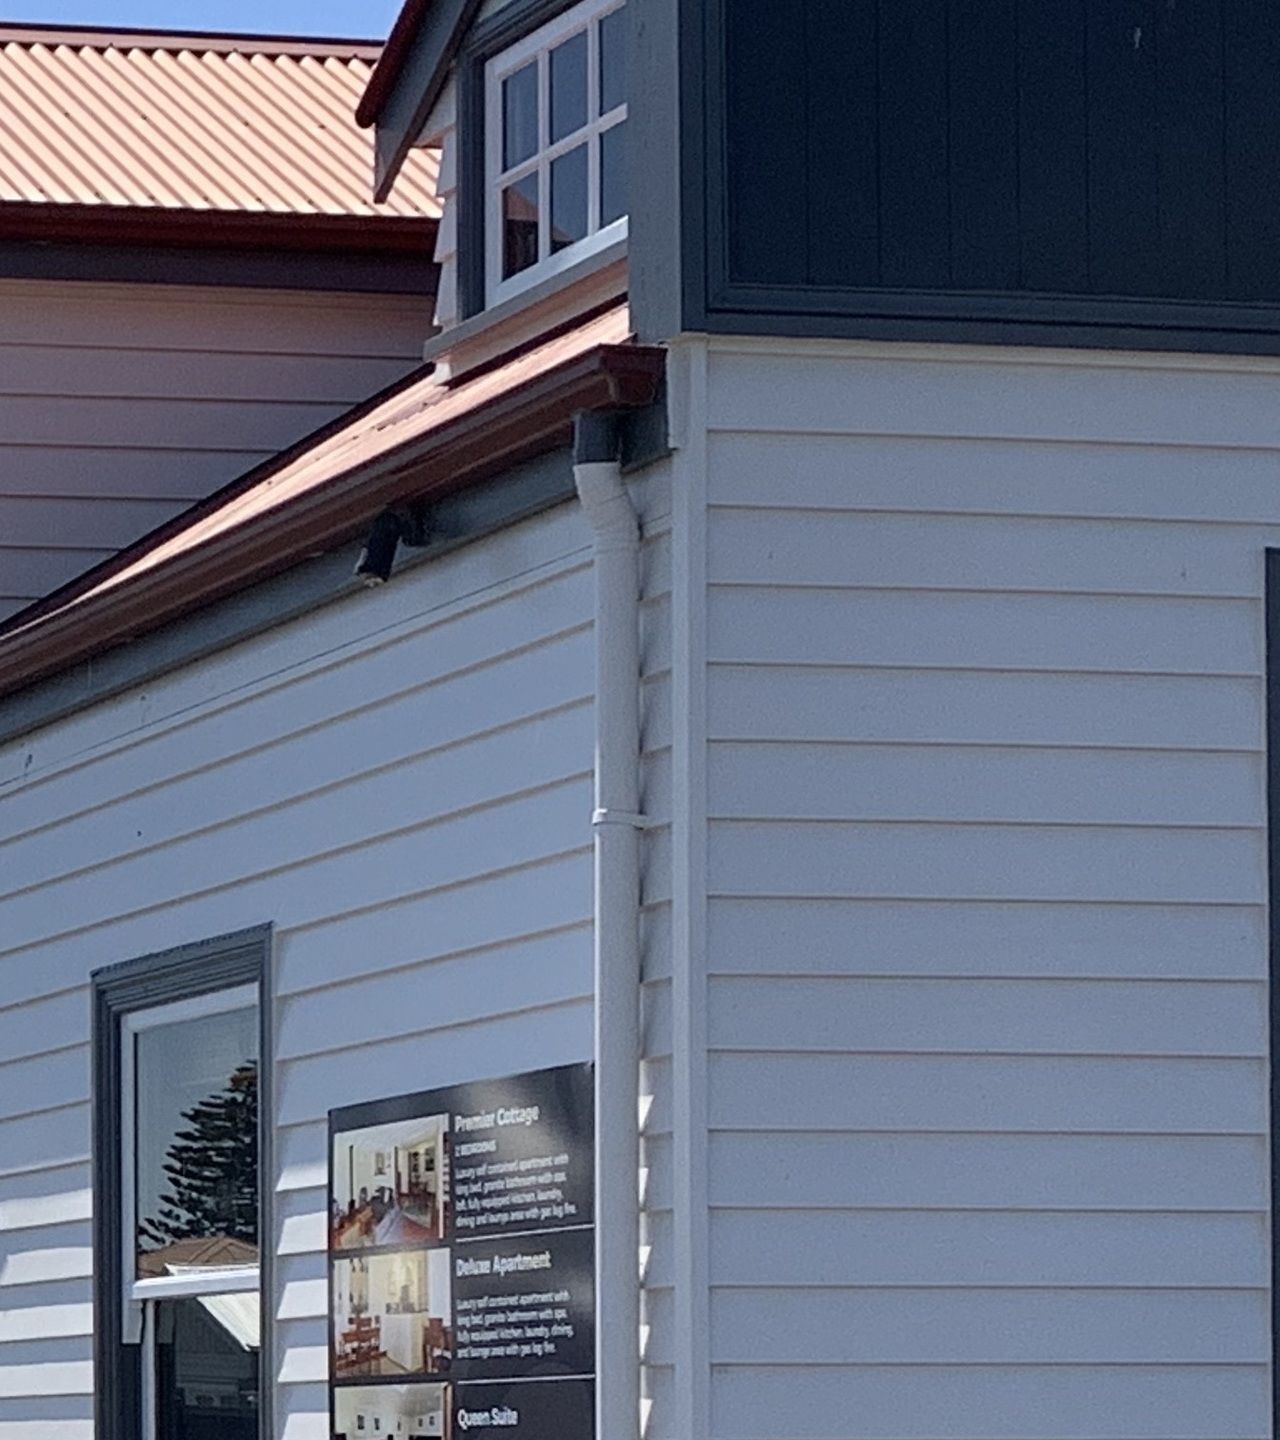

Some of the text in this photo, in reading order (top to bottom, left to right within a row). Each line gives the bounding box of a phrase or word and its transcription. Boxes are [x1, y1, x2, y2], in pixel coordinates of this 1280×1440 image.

[455, 1106, 540, 1132] Premier Cottage
[456, 1251, 552, 1277] Deluxe Apartment
[457, 1407, 518, 1430] Queen Suite
